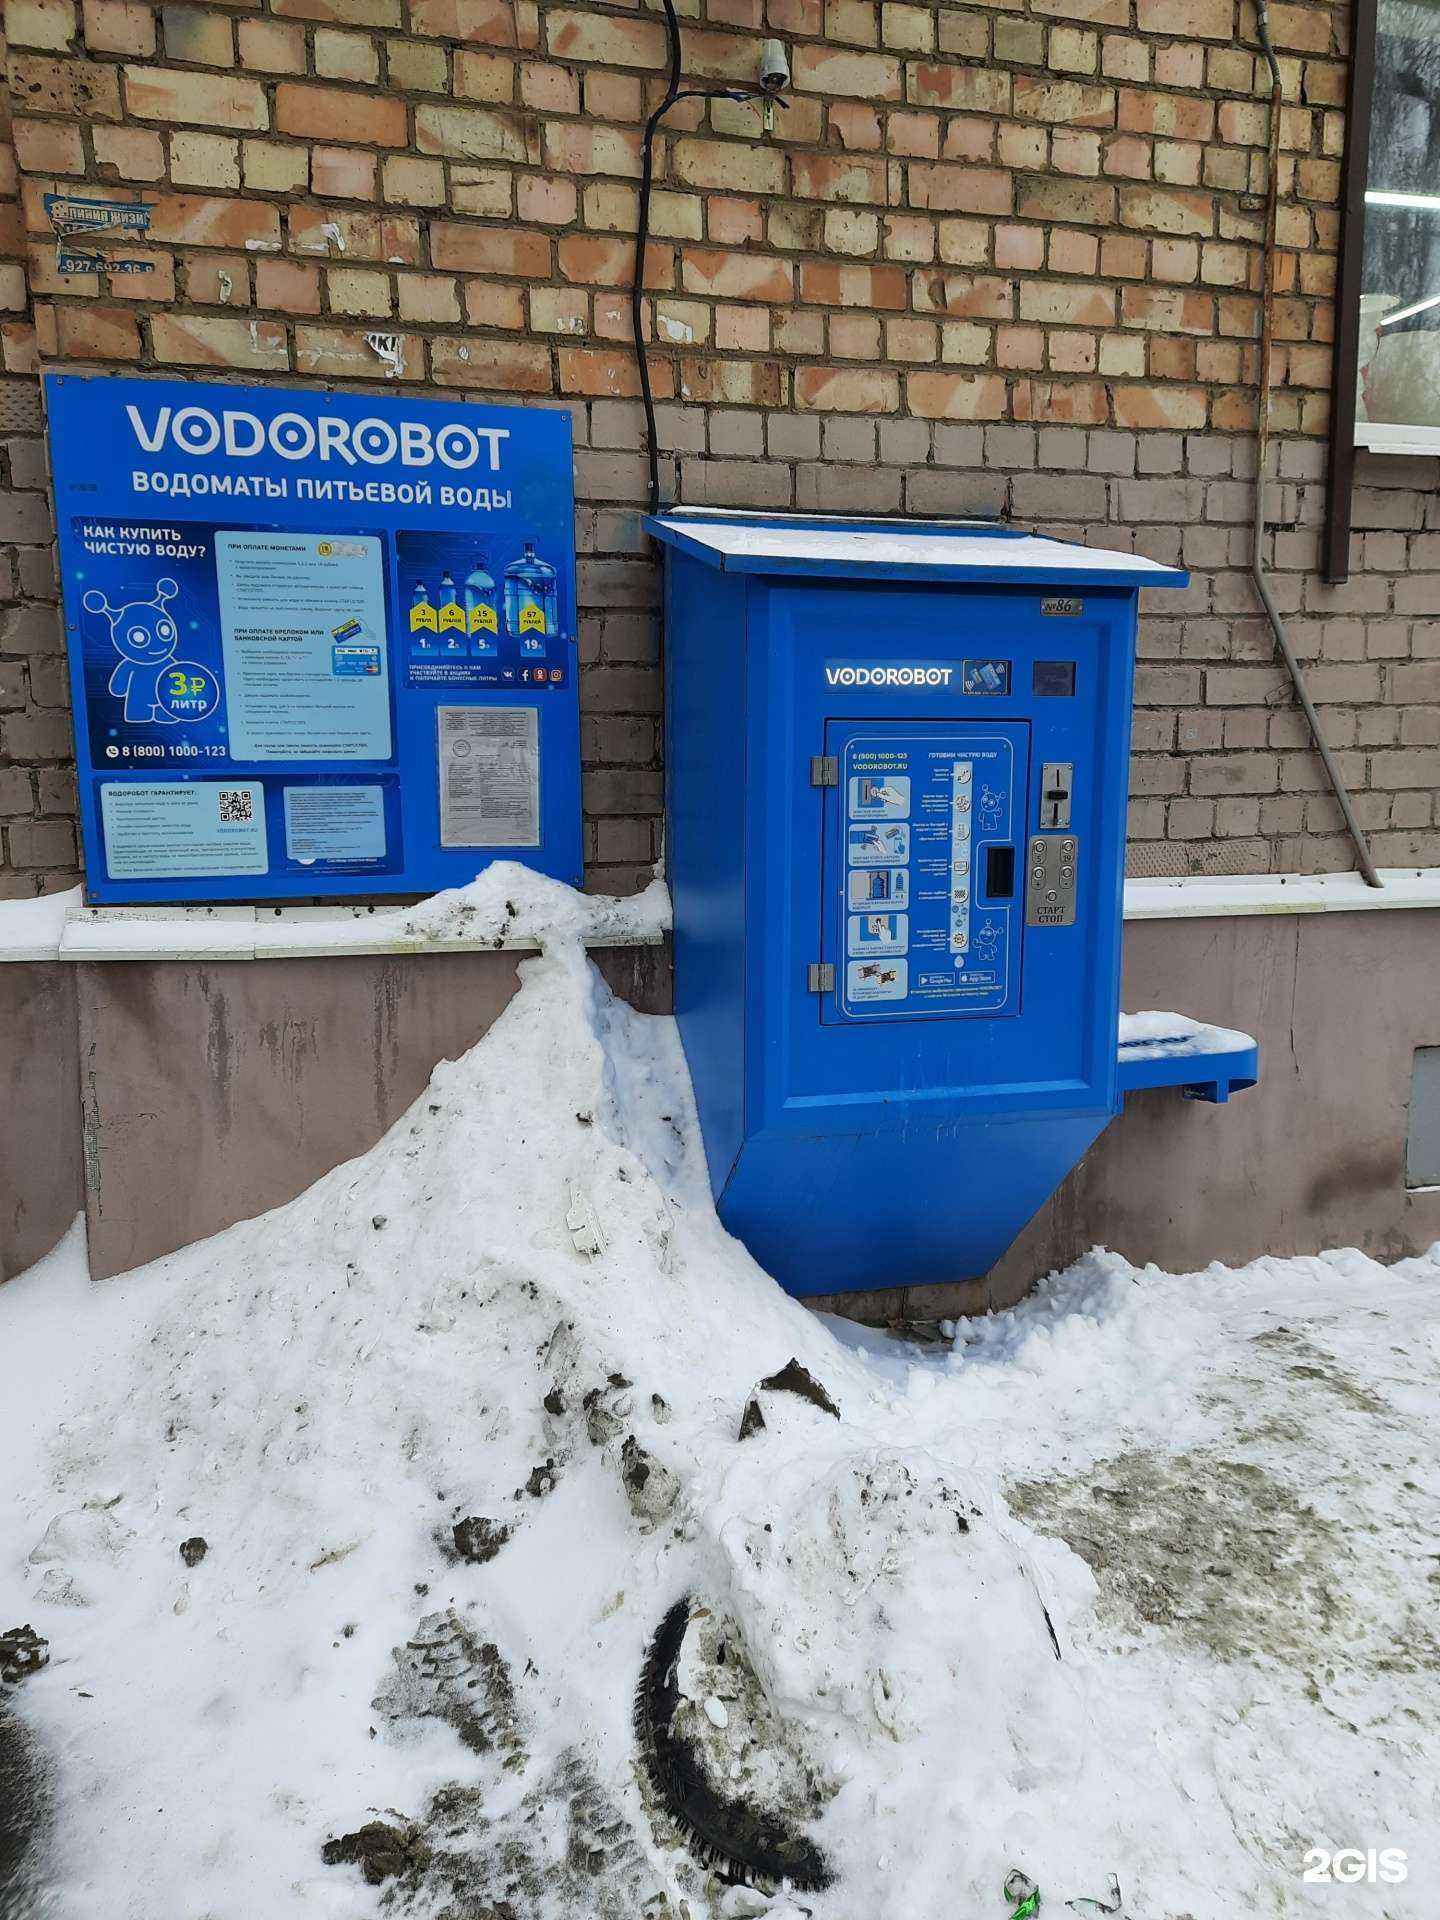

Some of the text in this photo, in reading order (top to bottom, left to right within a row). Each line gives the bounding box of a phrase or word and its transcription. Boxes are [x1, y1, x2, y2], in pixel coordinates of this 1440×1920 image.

[125, 405, 510, 471] VODOROBOT
[132, 471, 512, 512] ВОДОМАТЫ ПИТЬЕВОЙ ВОДЫ
[83, 525, 182, 542] КАК КУПИТЬ
[84, 541, 206, 559] ЧИСТУЮ ВОДУ?
[825, 667, 952, 687] VODOROBOT
[122, 745, 226, 759] 8 (800) 1000-123
[1037, 906, 1065, 915] СТАРТ
[1038, 915, 1064, 923] СТОП
